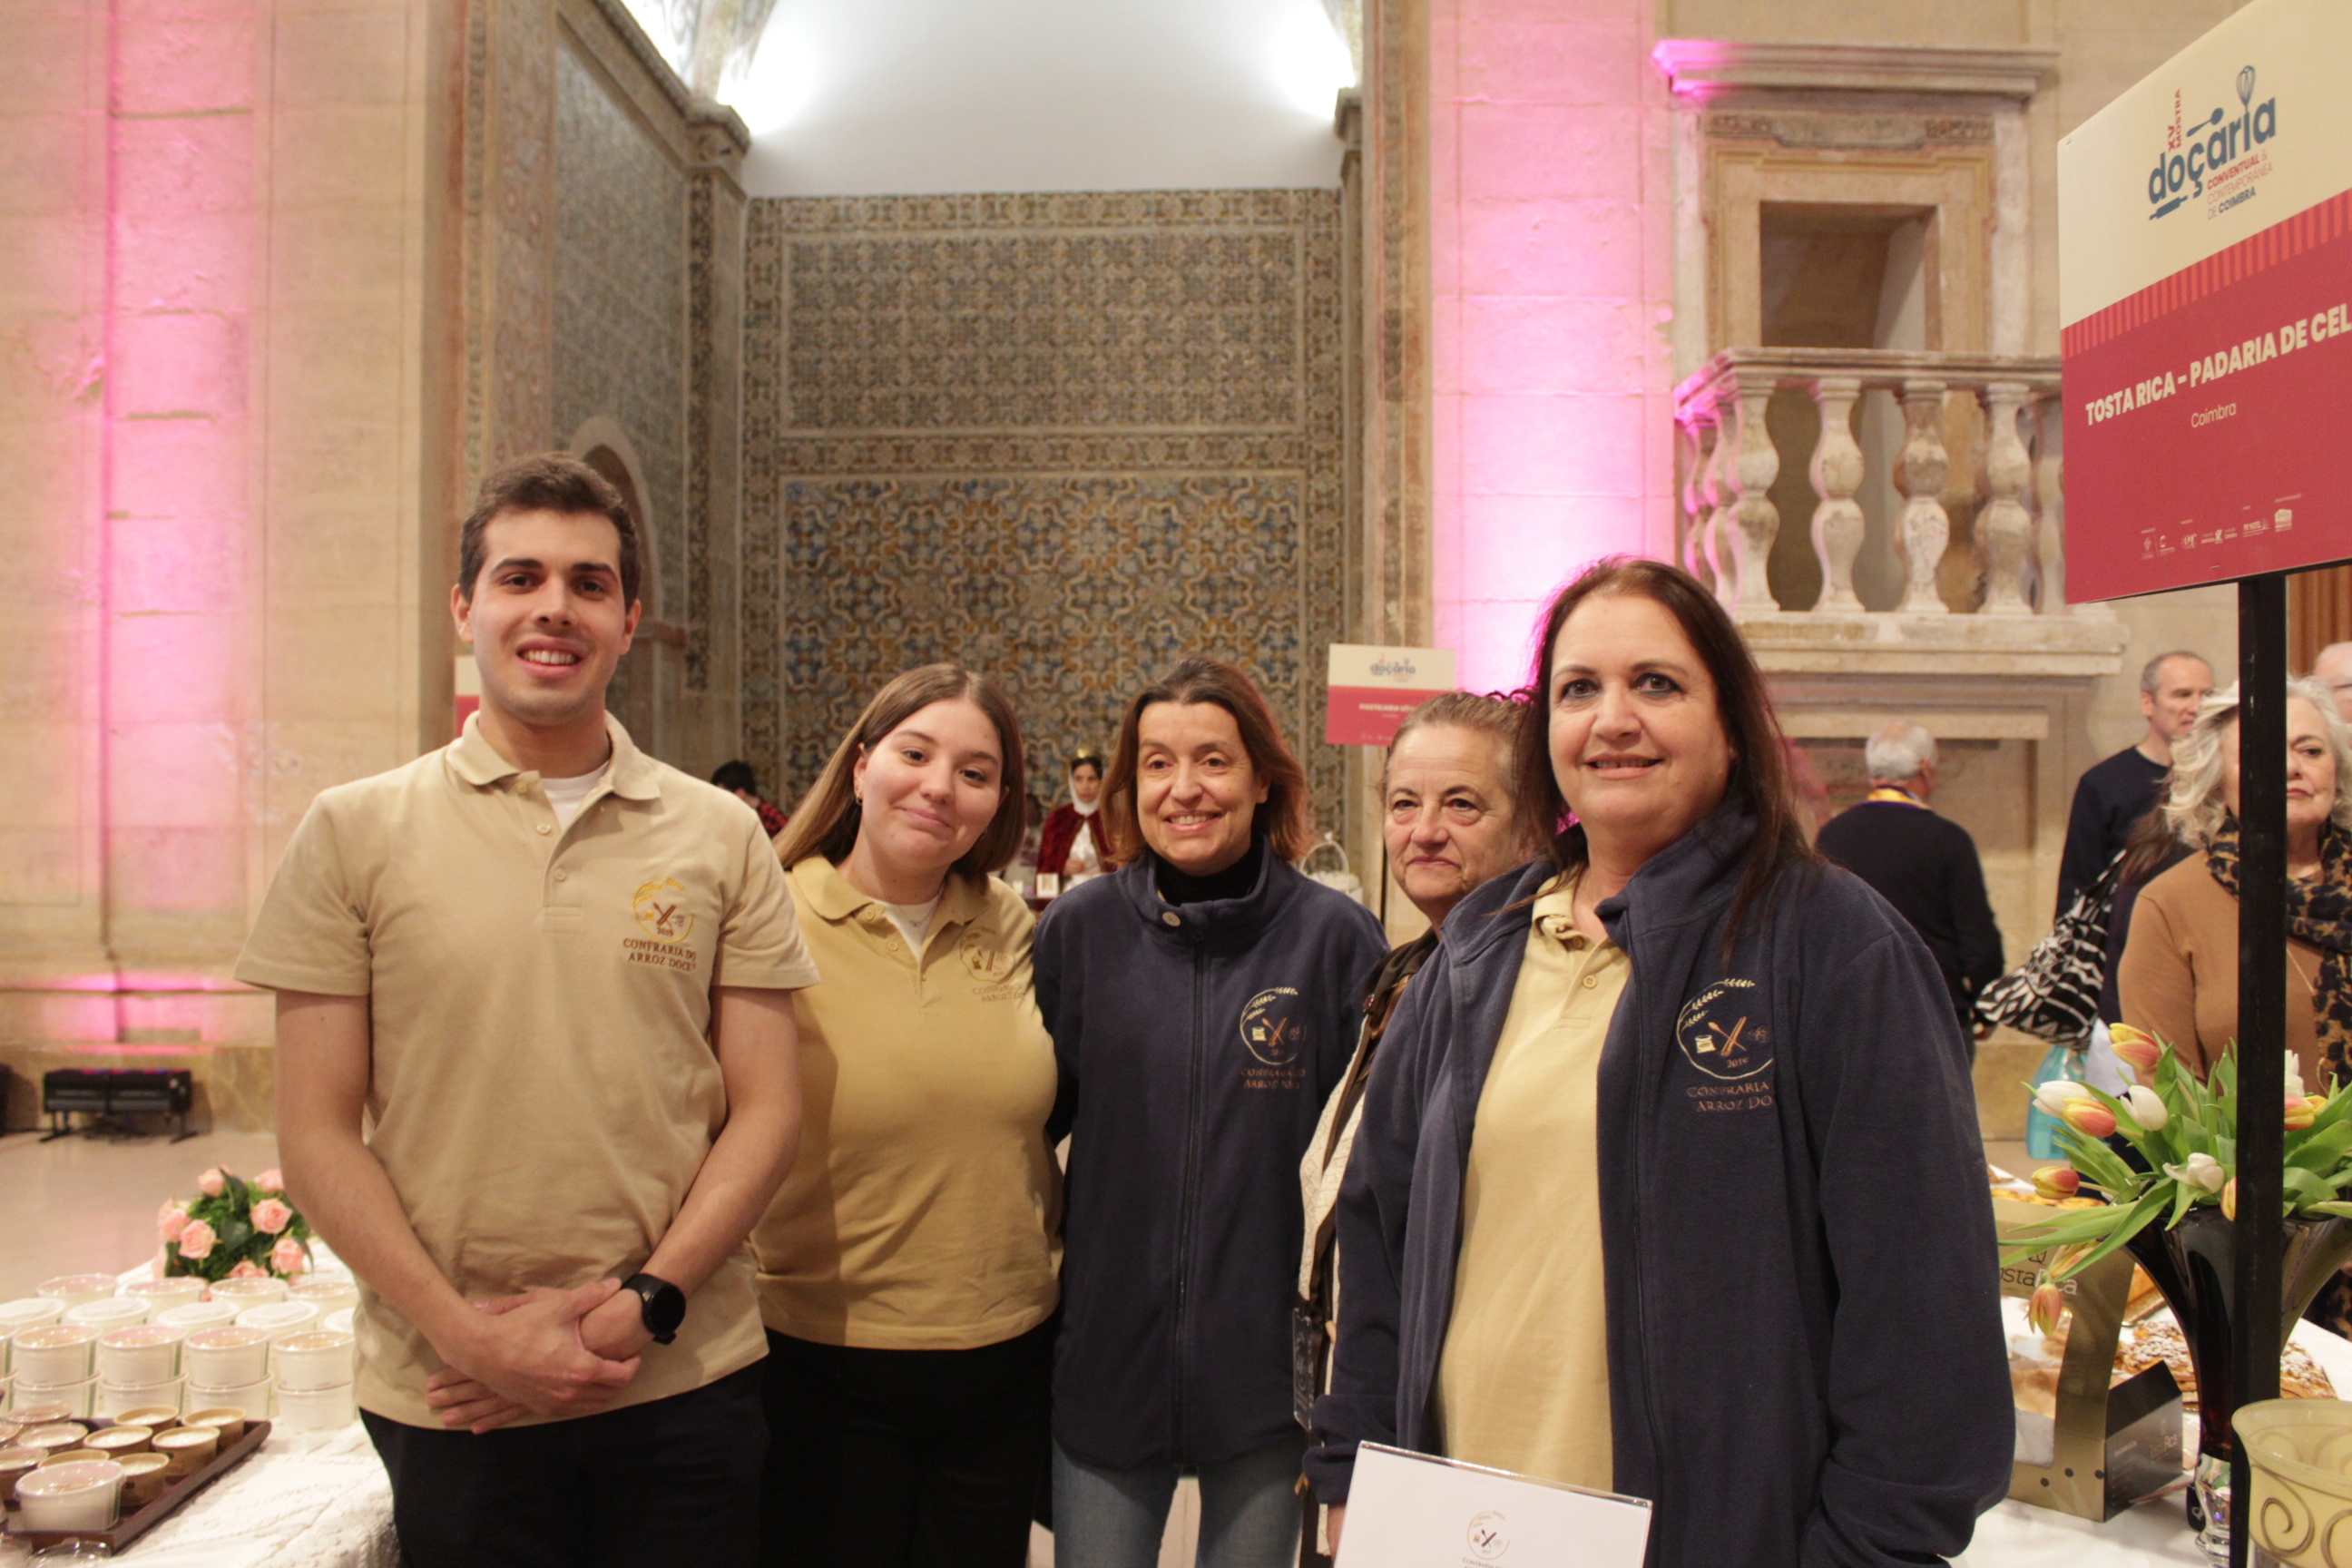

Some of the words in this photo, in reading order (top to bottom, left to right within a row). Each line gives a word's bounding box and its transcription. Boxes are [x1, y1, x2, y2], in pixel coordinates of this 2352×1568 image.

[2149, 96, 2276, 204] doçaria
[2207, 153, 2260, 190] CONVENTUAL
[2207, 162, 2273, 205] CONTEMPORÂNEA
[2208, 206, 2218, 220] DE
[2219, 186, 2256, 213] COIMBRA
[2085, 387, 2134, 426] TOSTA
[2135, 371, 2177, 409] RICA
[2190, 332, 2278, 388] PADARIA
[2279, 318, 2308, 356] DE
[2310, 303, 2352, 343] CEL
[2190, 403, 2237, 428] Coimbra
[623, 938, 683, 958] CONFRARIA
[685, 949, 696, 962] DO
[629, 952, 666, 965] ARROZ
[1687, 1082, 1770, 1097] CONFRARIA
